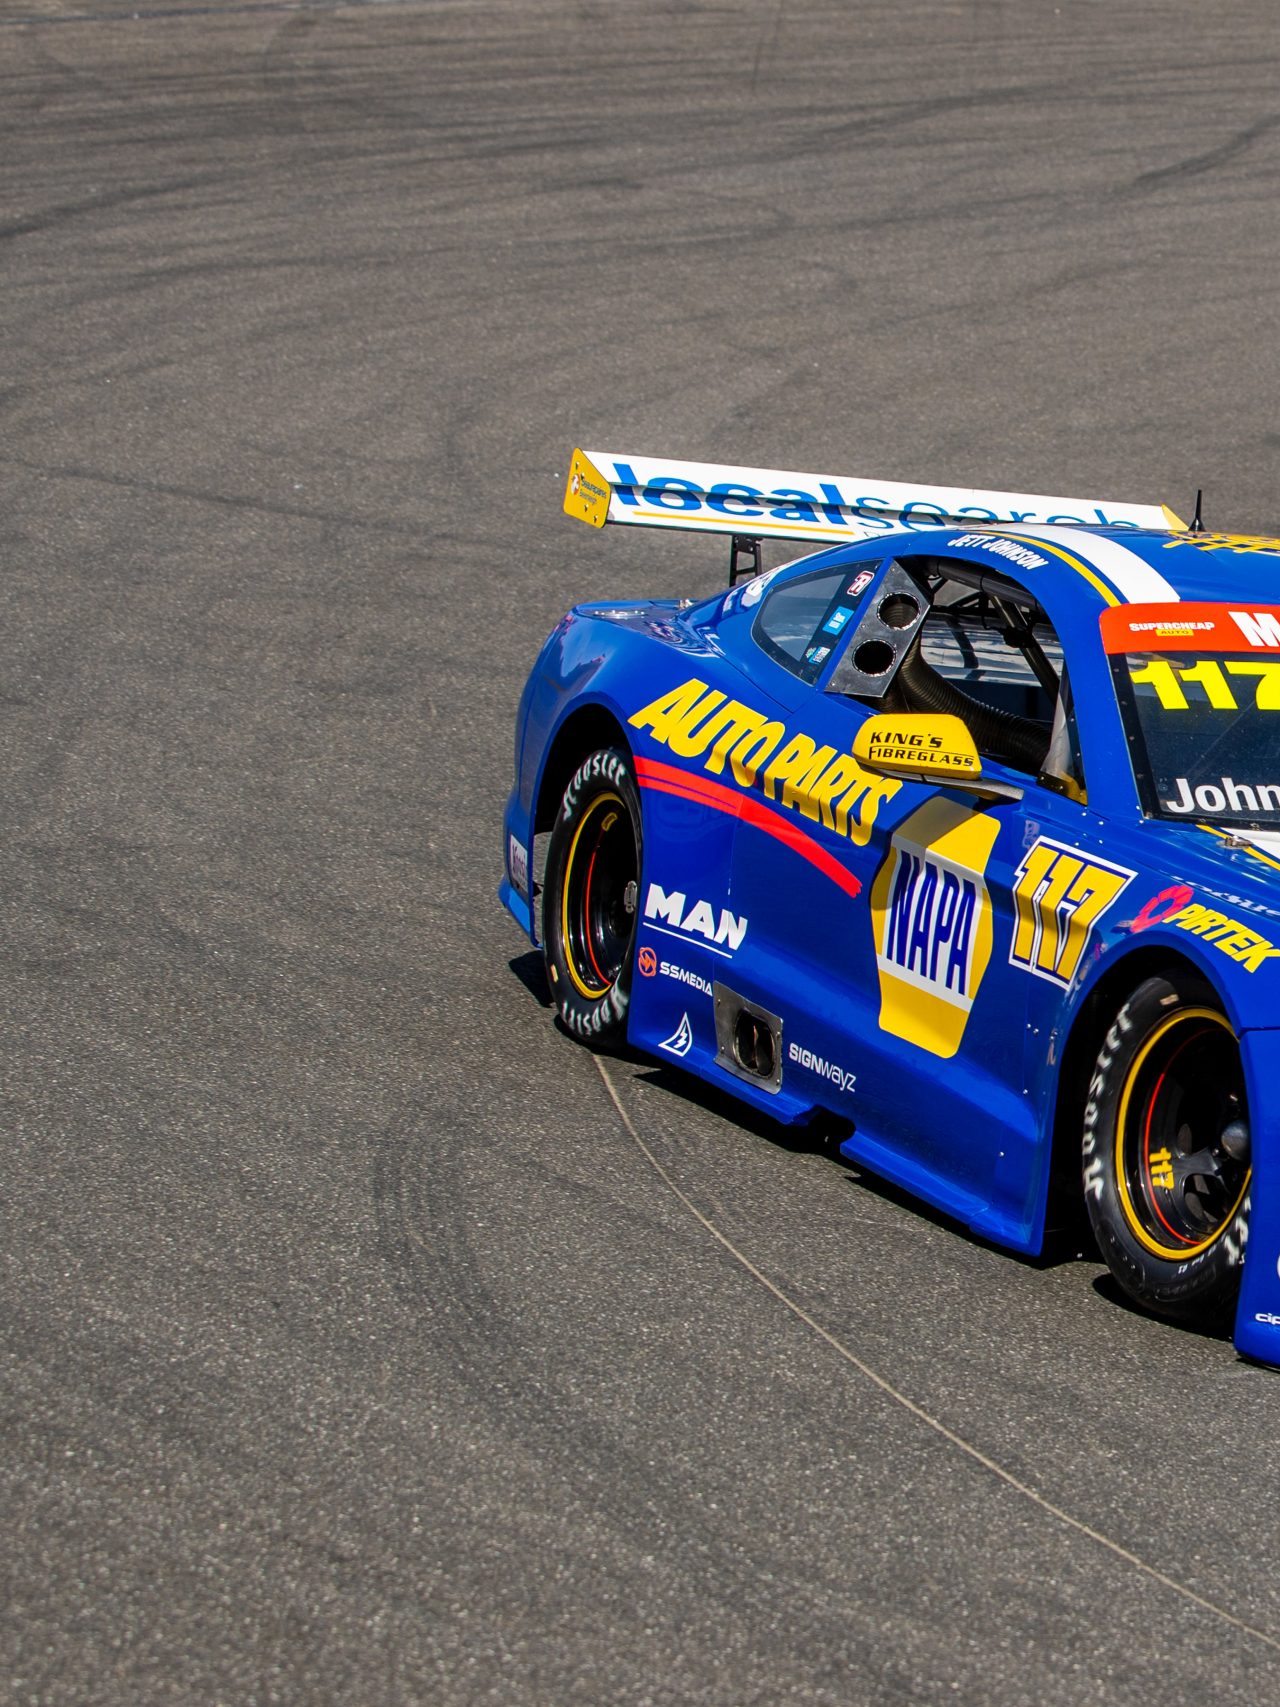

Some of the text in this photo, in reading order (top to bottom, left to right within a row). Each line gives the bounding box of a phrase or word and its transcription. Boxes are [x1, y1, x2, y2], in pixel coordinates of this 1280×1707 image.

[947, 534, 1049, 570] JETT JOHNSON
[1129, 621, 1216, 632] SUPERCHEAP
[868, 747, 974, 767] FIBREGLASS
[870, 732, 943, 749] KING'S
[627, 678, 904, 847] AUTO PARTS
[644, 882, 748, 951] MAN
[886, 849, 976, 996] NAPA
[1010, 841, 1131, 986] 117
[659, 961, 714, 997] SSMEDIA
[788, 1042, 857, 1092] SIGNwayz
[1149, 1147, 1175, 1189] 117
